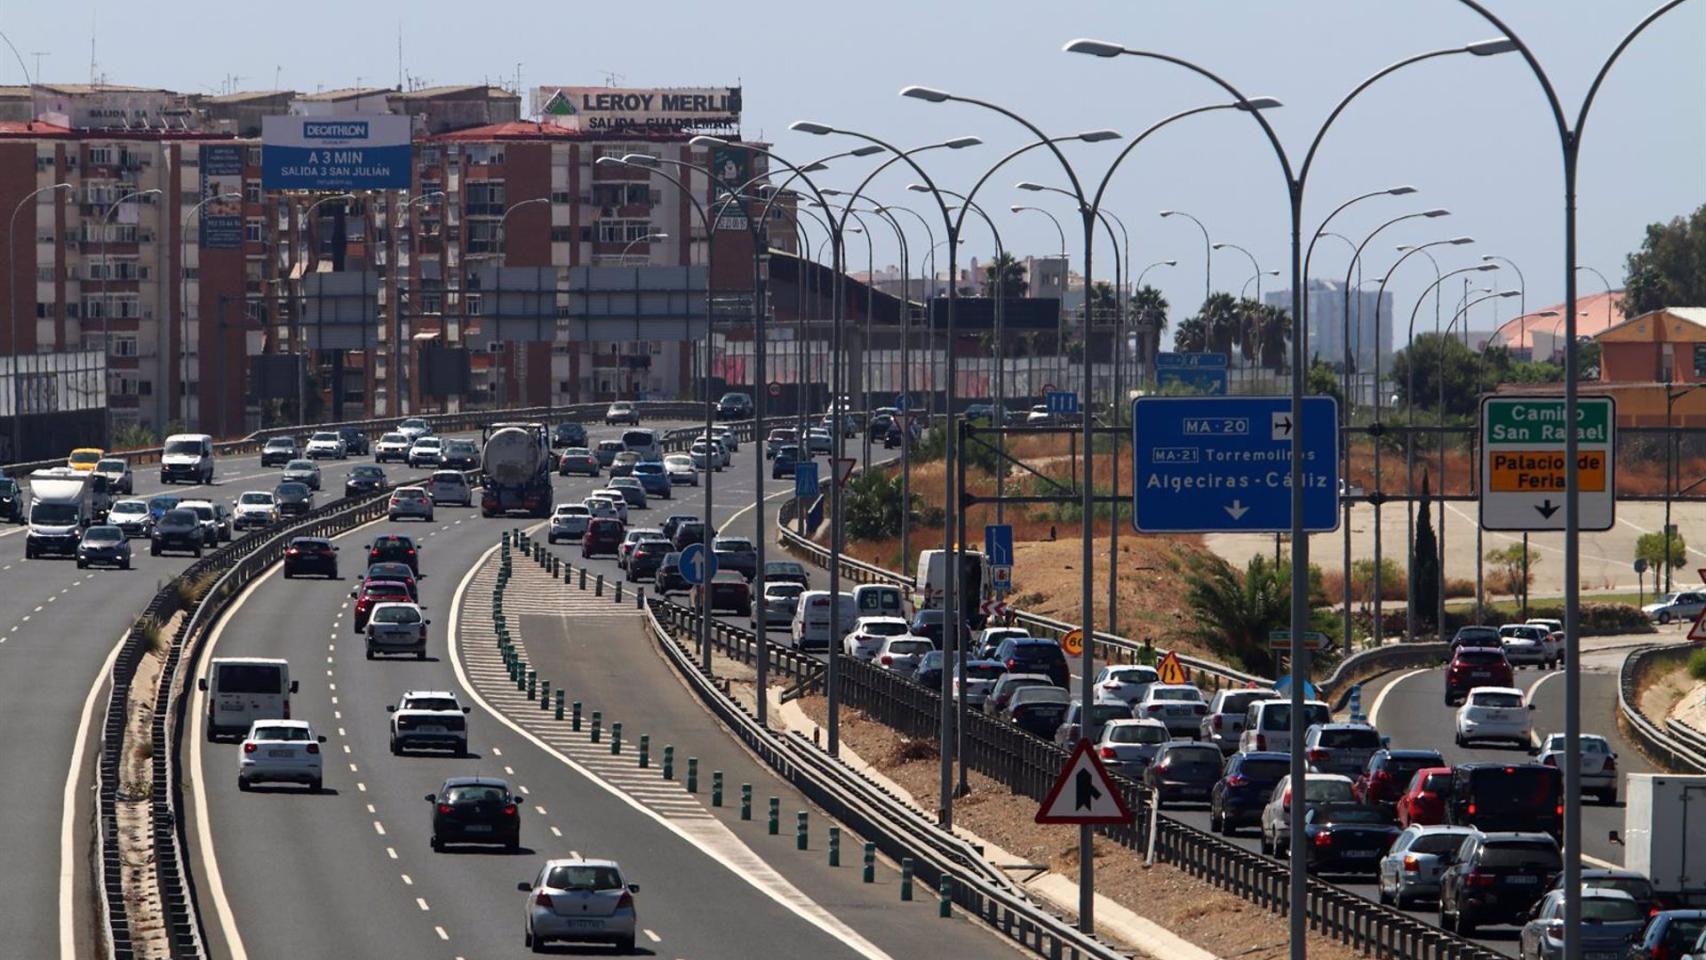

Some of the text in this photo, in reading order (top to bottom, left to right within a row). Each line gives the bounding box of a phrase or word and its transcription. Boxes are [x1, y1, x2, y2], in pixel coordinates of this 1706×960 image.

[583, 94, 653, 112] LEROY
[306, 125, 366, 136] DECATHLON
[589, 117, 636, 129] SALIDA
[308, 151, 363, 164] A 3 MIN
[281, 167, 318, 176] SALIDA
[320, 167, 327, 176] 3
[329, 167, 350, 176] SAN
[1511, 405, 1584, 421] Camio
[1492, 424, 1604, 439] San Raael
[1494, 455, 1600, 470] Palacio de
[1147, 472, 1249, 493] Algeciras
